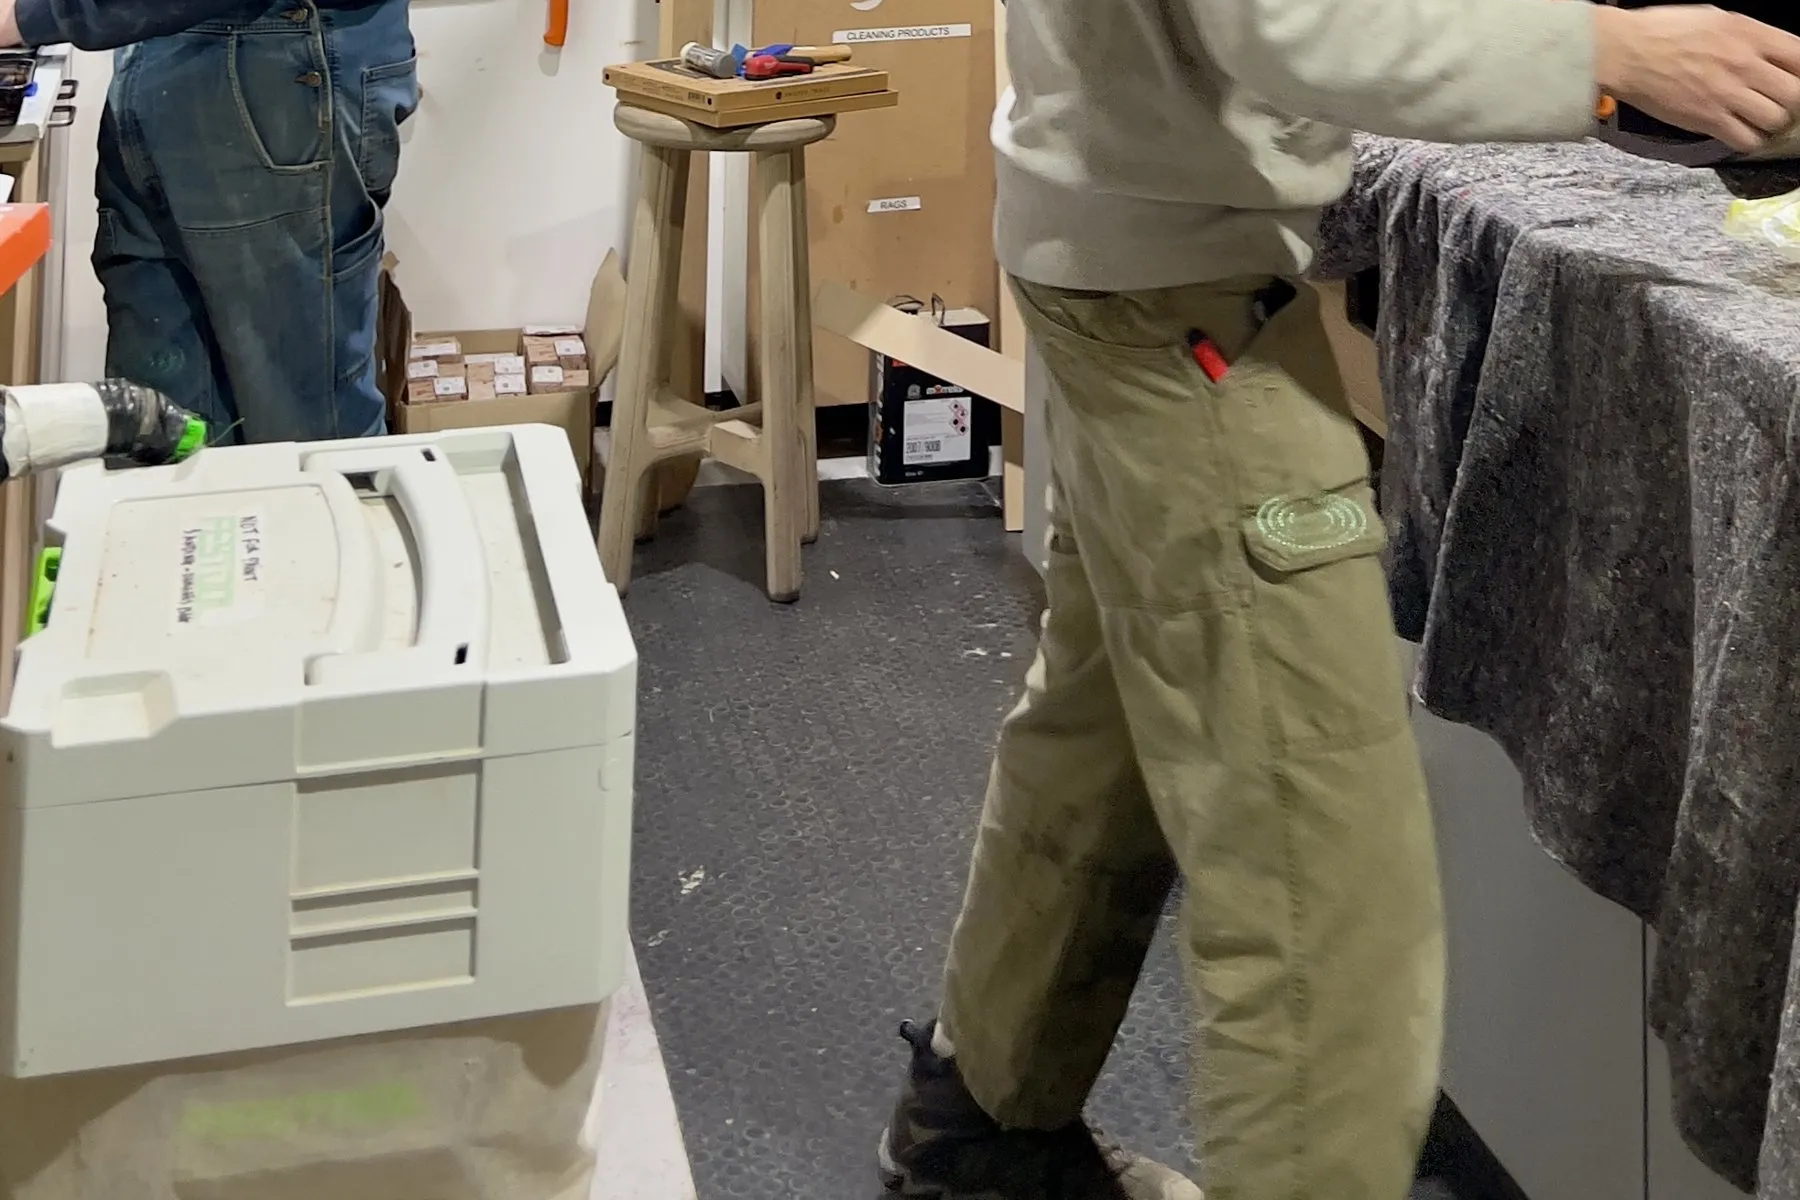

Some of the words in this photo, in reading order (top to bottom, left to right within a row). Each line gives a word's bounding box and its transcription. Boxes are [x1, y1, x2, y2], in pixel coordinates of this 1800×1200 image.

[846, 29, 895, 41] CLEANING
[897, 26, 950, 38] PRODUCTS
[880, 199, 908, 210] RAGS
[239, 515, 259, 534] NOT
